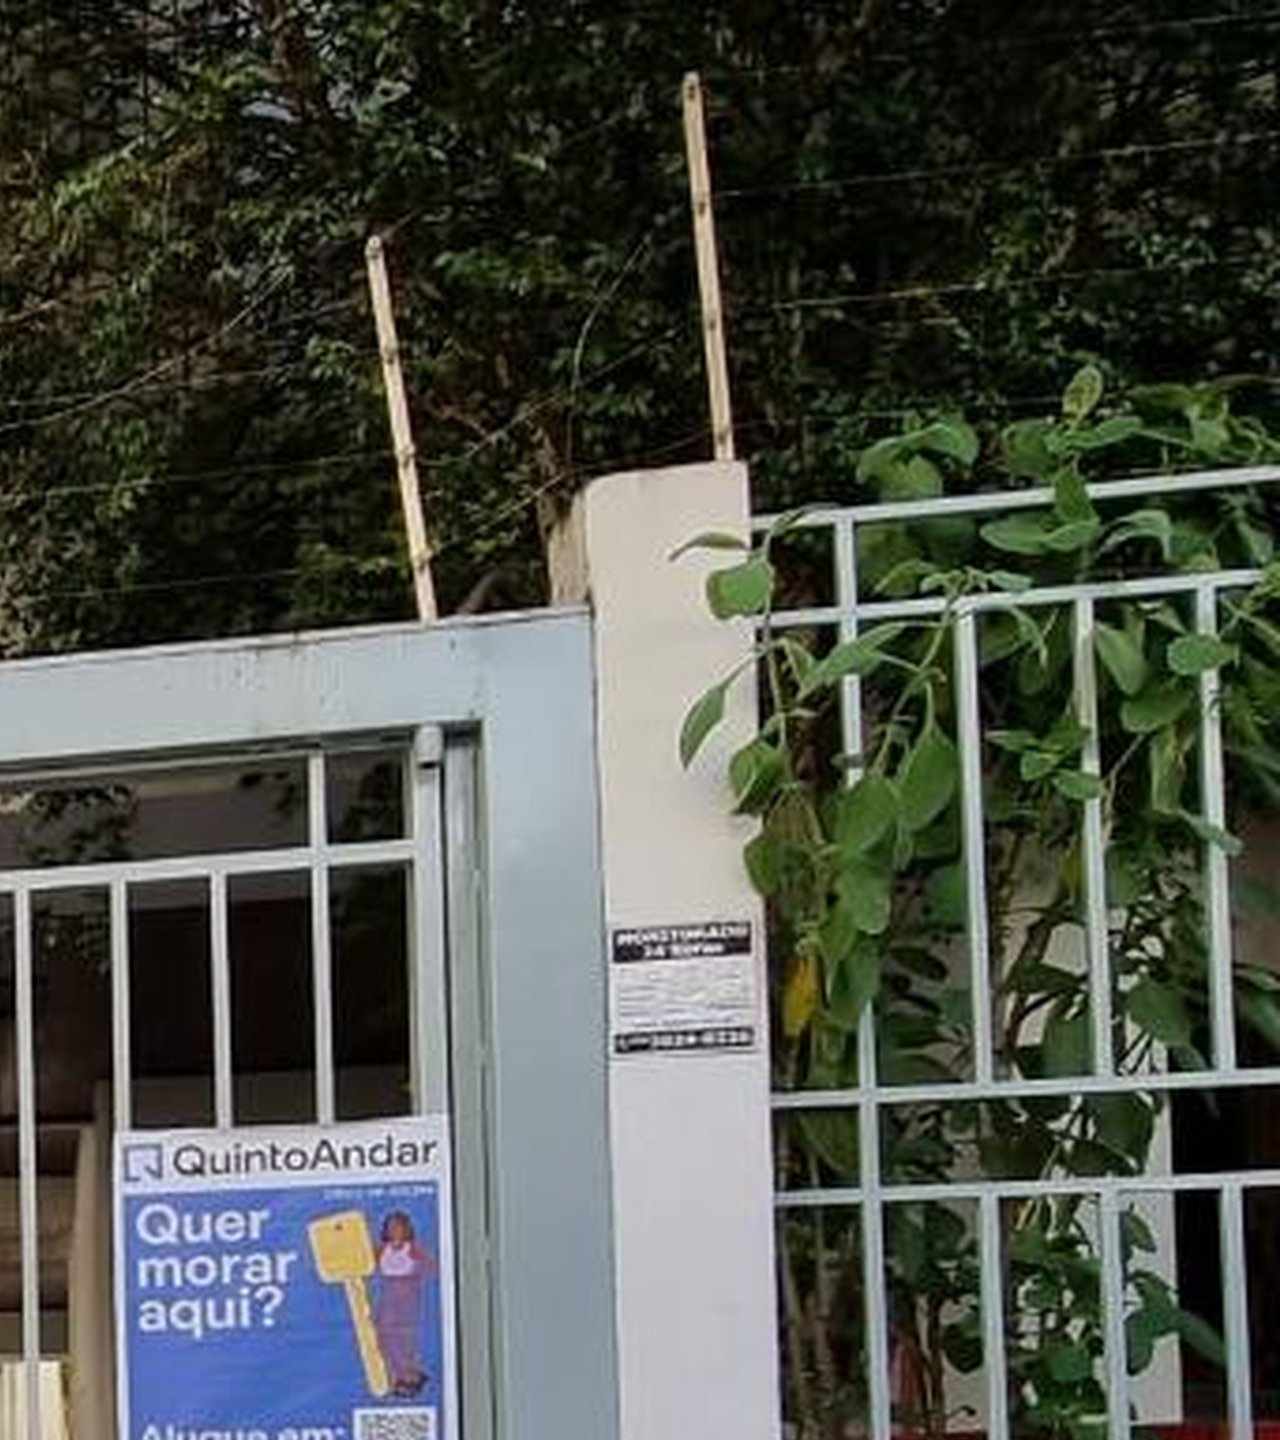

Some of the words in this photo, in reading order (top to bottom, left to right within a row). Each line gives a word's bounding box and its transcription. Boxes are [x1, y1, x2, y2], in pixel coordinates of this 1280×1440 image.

[173, 1135, 438, 1177] QuintoAndar
[136, 1202, 270, 1246] Quer
[137, 1251, 298, 1288] morar
[138, 1284, 284, 1339] aqui?
